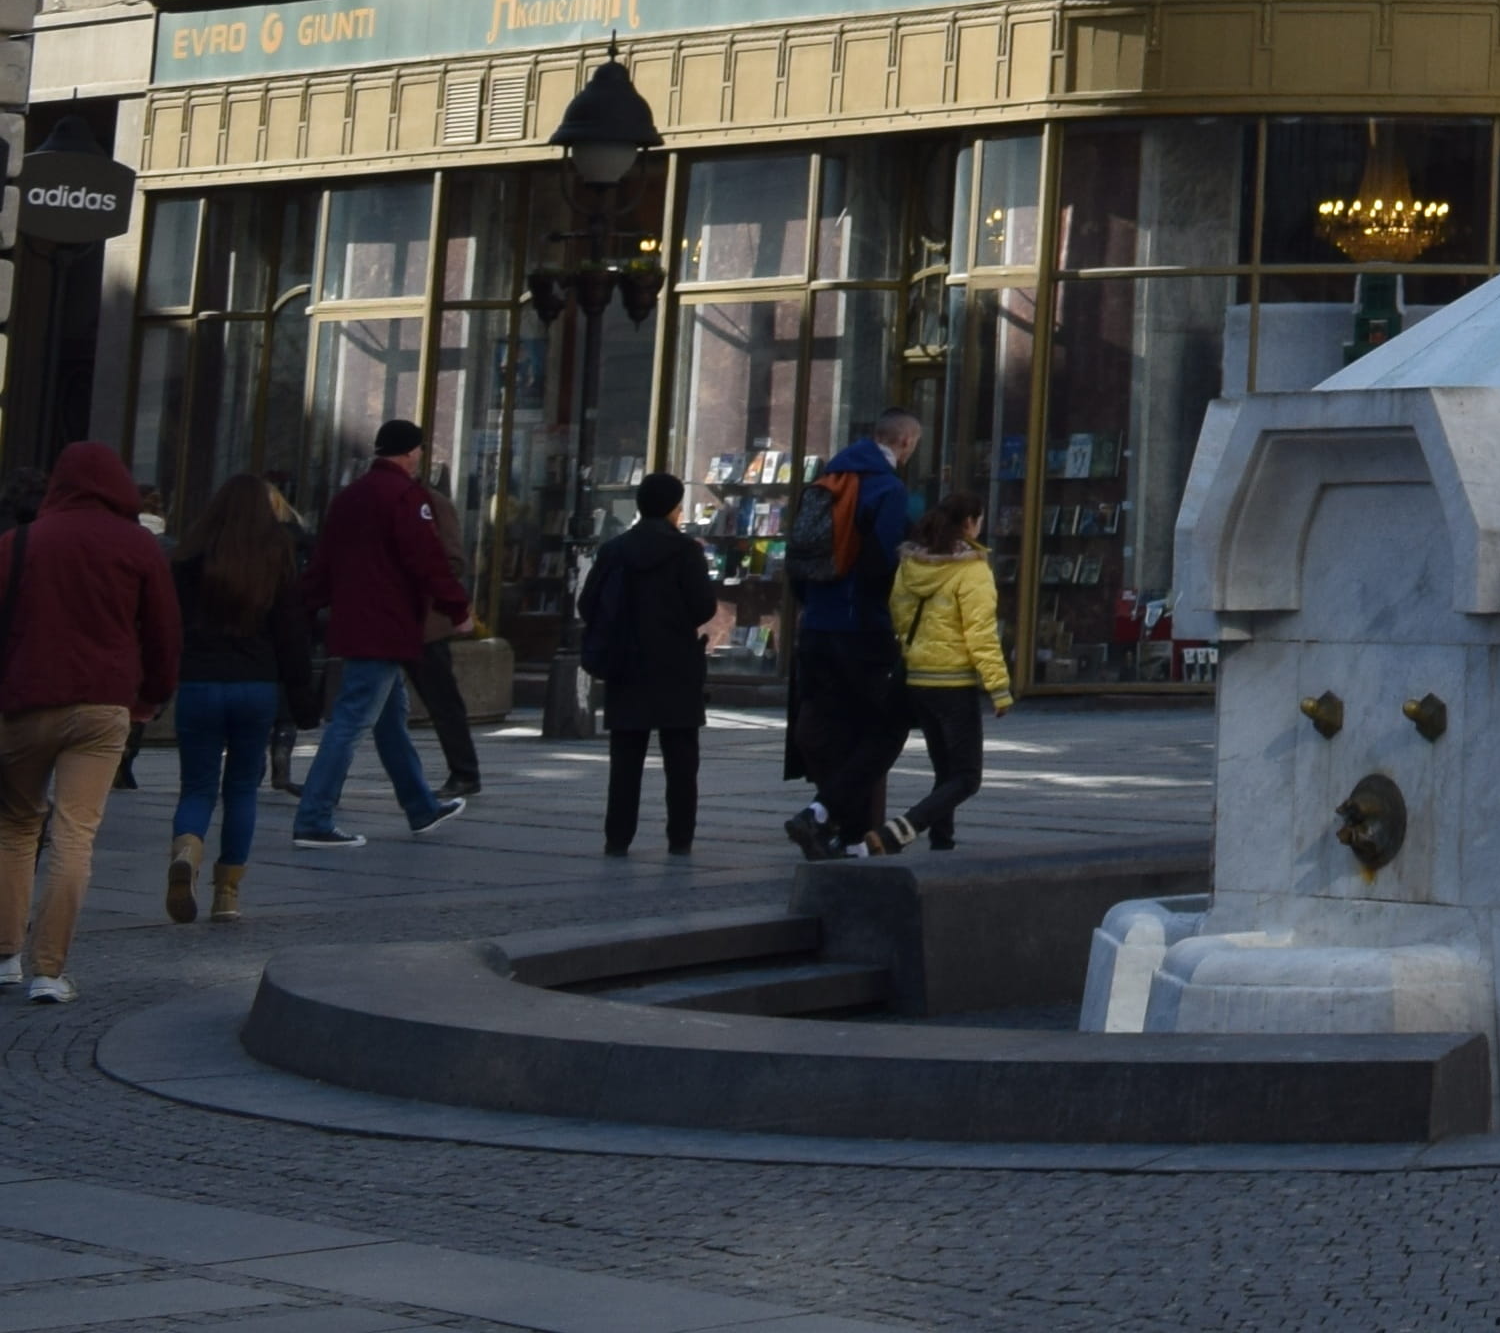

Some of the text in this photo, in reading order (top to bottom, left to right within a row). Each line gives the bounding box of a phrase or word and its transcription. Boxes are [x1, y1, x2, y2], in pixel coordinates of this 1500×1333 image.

[172, 22, 247, 60] EVRO
[298, 7, 376, 47] GIUNTI
[28, 185, 117, 211] adidas
